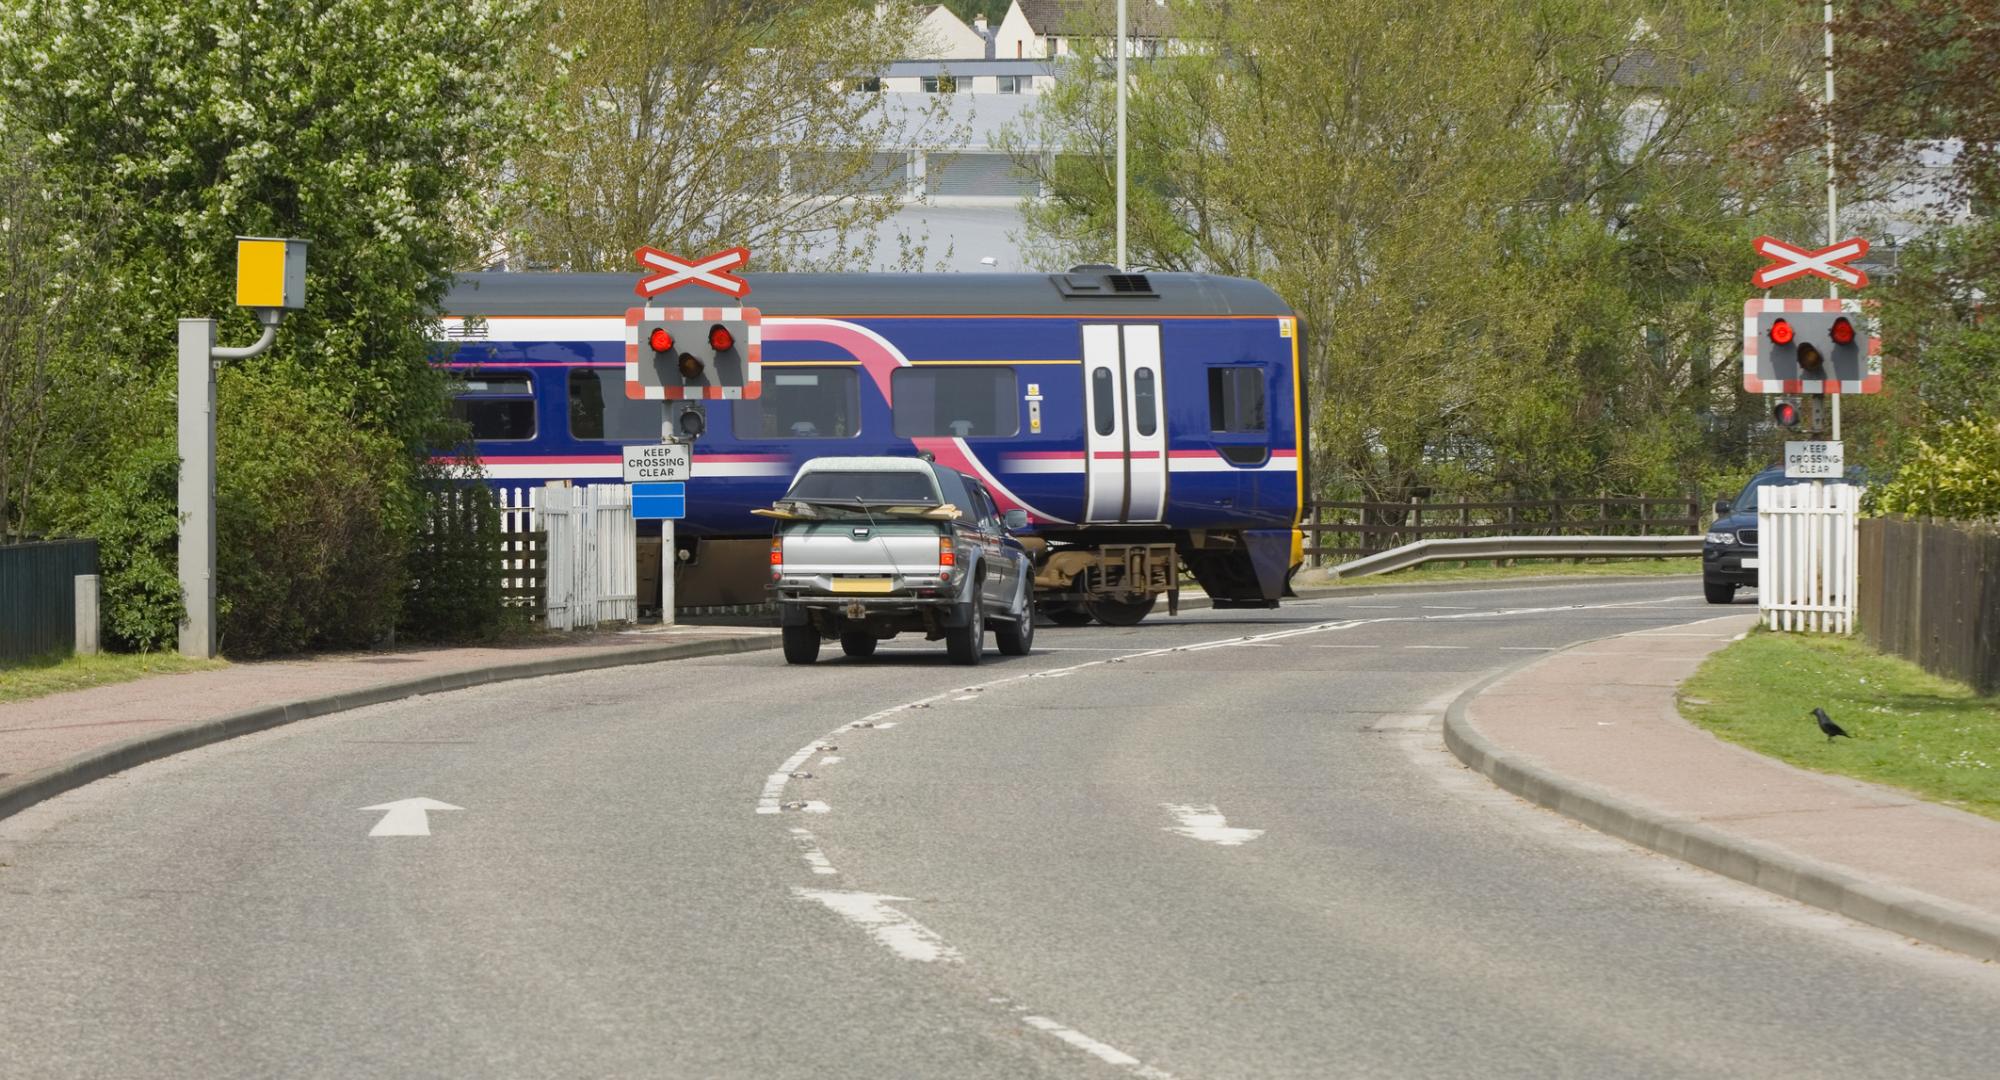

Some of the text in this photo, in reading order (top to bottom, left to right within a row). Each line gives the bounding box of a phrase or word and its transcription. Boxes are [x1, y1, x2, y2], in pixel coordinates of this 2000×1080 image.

[628, 458, 684, 468] CROSSING
[640, 468, 674, 477] CLEAR
[1799, 465, 1830, 474] CLEAR
